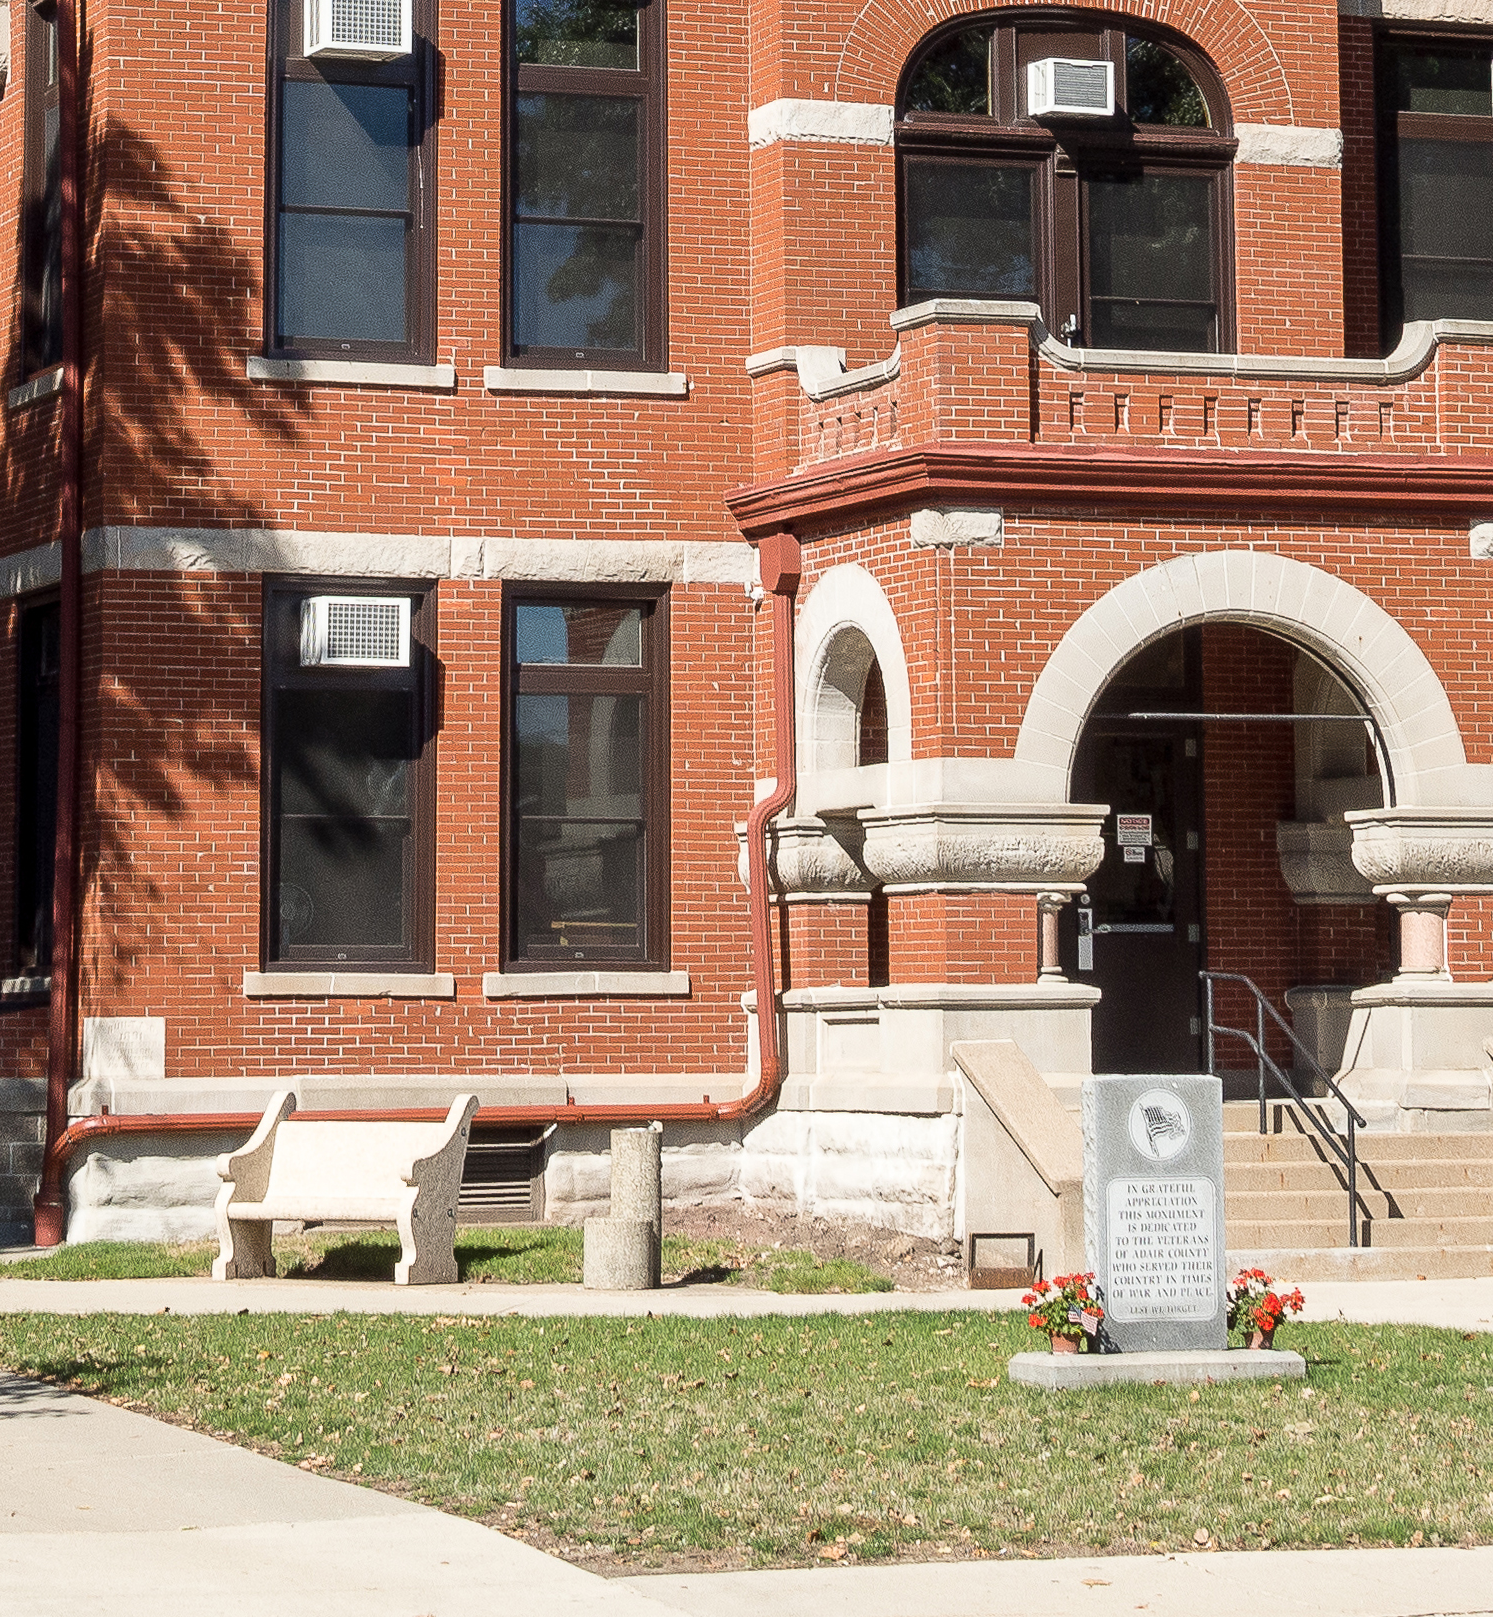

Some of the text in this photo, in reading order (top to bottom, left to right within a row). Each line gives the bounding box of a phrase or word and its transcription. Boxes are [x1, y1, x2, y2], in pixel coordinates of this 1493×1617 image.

[1127, 1184, 1195, 1194] IN GRATEFUL
[1126, 1197, 1198, 1207] APPRECIATION
[1118, 1209, 1205, 1220] THIS MONUMENT
[1128, 1222, 1197, 1233] IS DEDICATED
[1115, 1234, 1209, 1246] TO THE VETERANS
[1115, 1248, 1209, 1259] OF ADAIR COUNTY
[1112, 1261, 1213, 1272] WHO SERVED THEIR
[1114, 1274, 1212, 1285] COUNTRY IN TIMES
[1112, 1289, 1125, 1298] OF
[1129, 1288, 1151, 1298] WAR
[1156, 1288, 1176, 1298] AND
